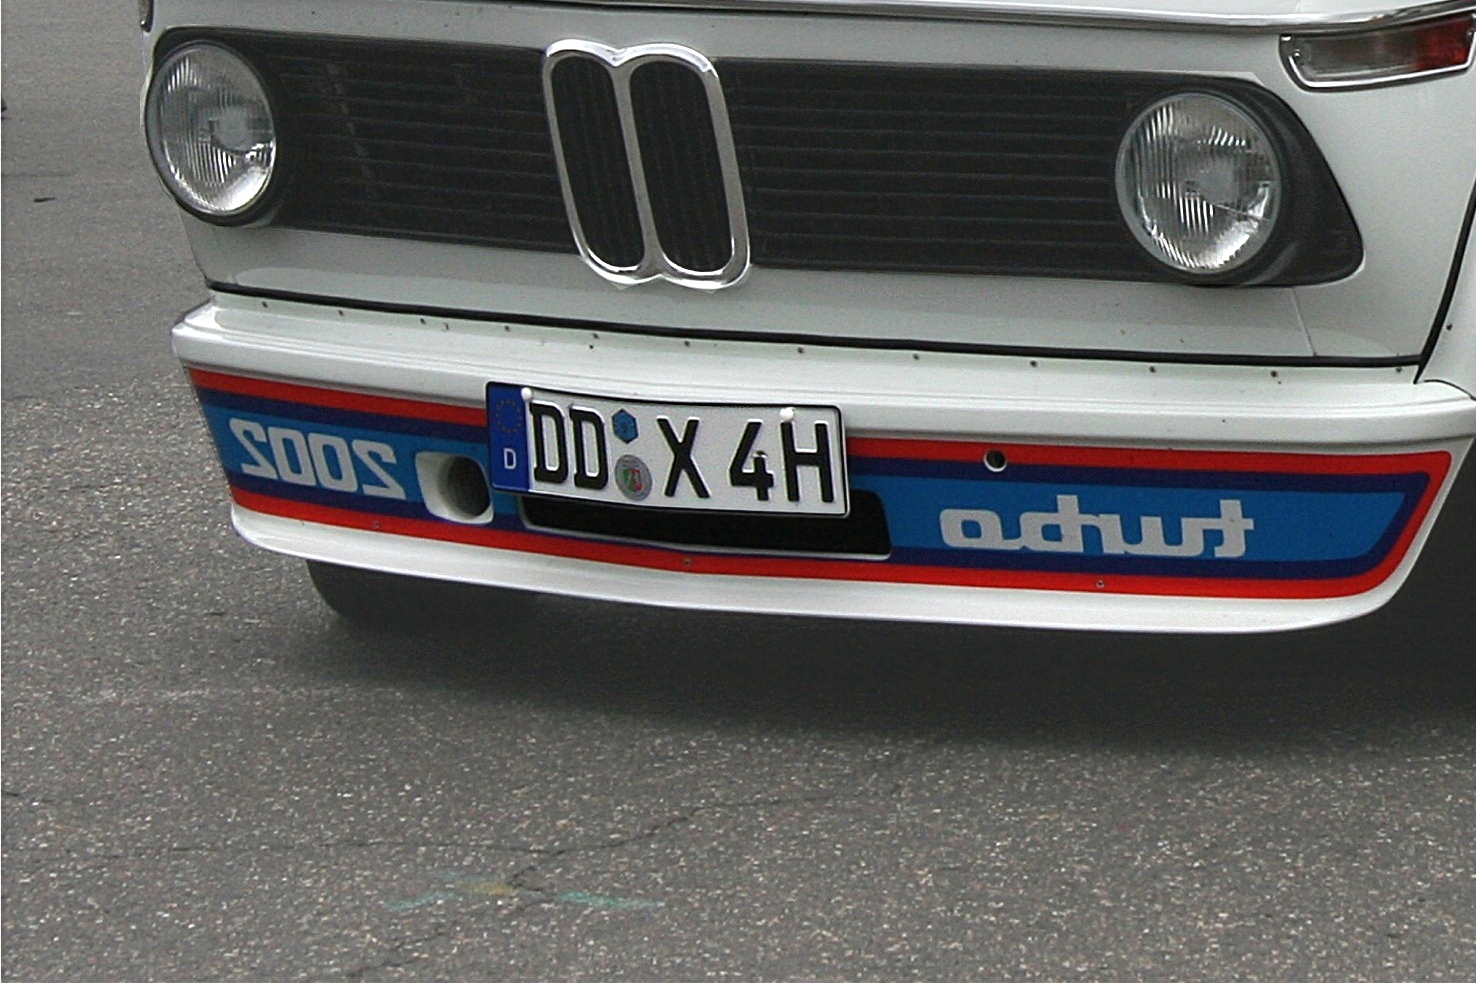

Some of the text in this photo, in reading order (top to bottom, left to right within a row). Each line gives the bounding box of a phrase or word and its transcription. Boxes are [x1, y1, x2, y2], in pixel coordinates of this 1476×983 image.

[503, 447, 517, 470] D
[529, 402, 609, 490] DD
[656, 416, 711, 498] X
[729, 419, 835, 503] 4H
